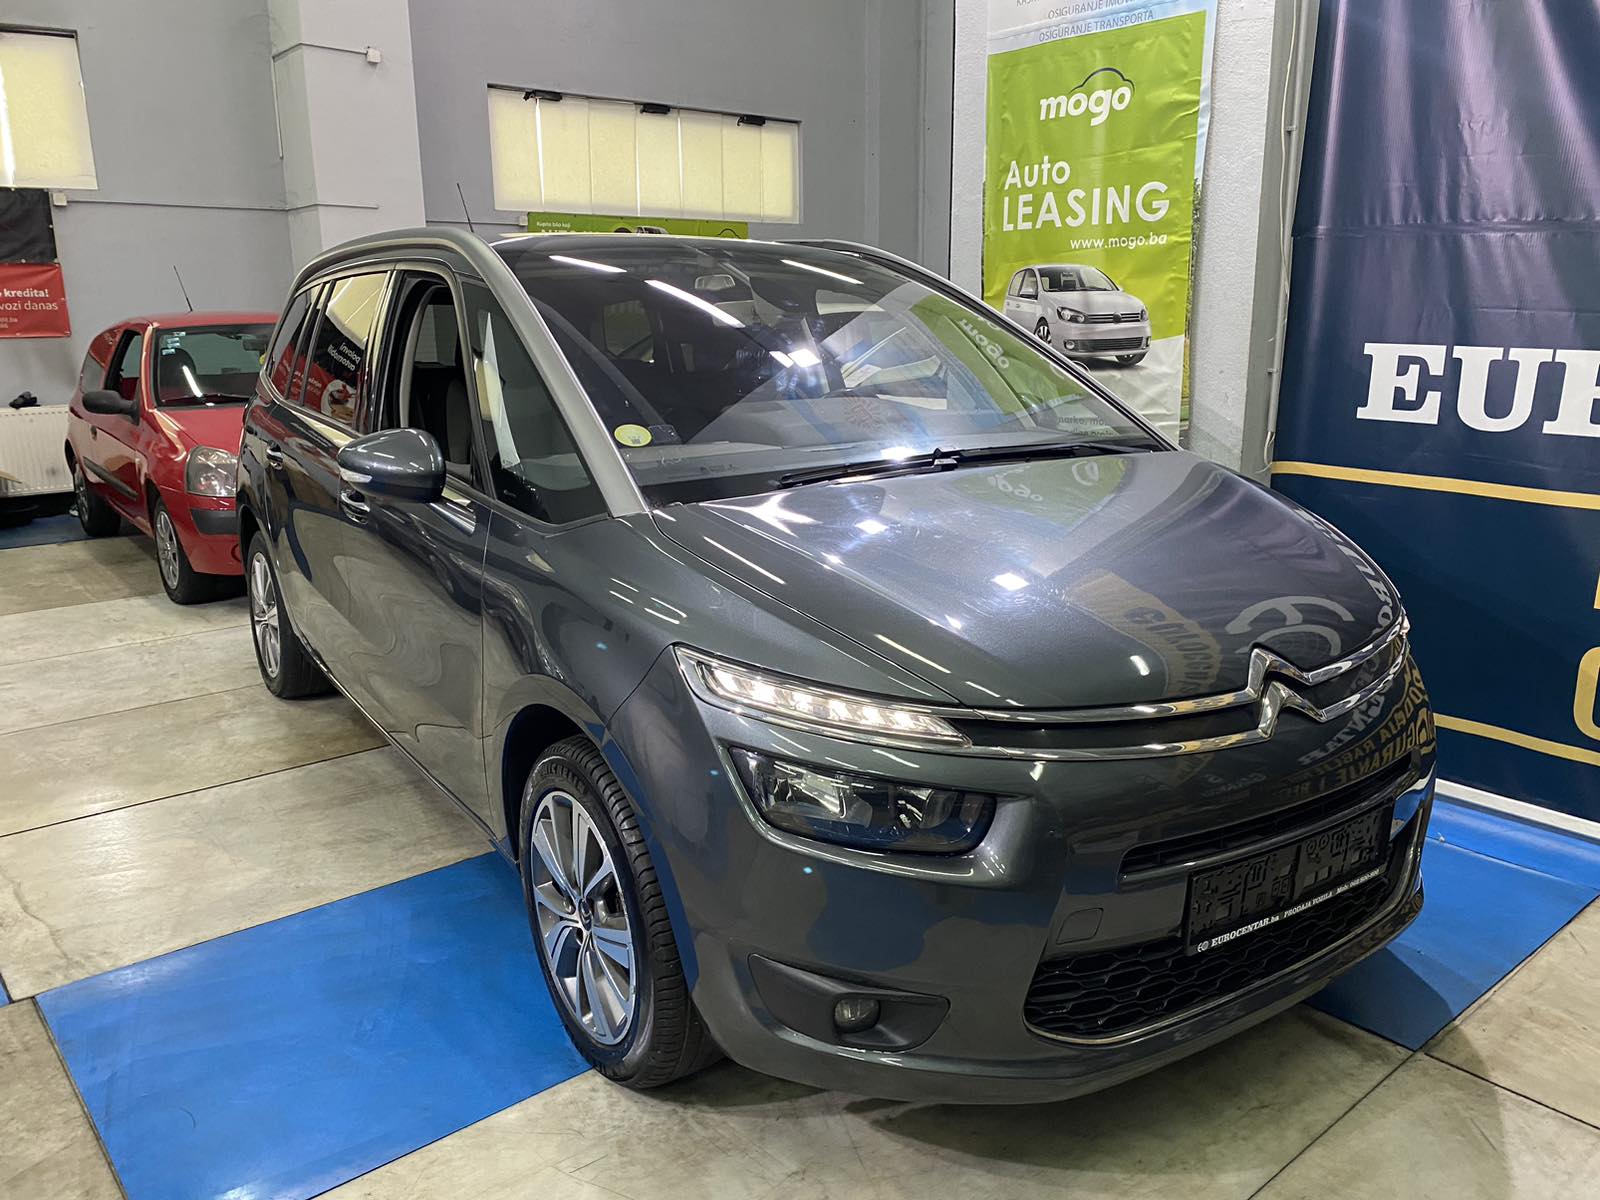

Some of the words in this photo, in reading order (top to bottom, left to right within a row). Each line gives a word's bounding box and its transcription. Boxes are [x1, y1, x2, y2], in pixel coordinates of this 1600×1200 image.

[1048, 1, 1104, 19] OSIGURANJE
[1038, 22, 1092, 42] OSIGURANJE
[1094, 10, 1154, 31] TRANSPORTA
[1039, 86, 1132, 126] mogo
[1004, 156, 1070, 190] Auto
[1002, 181, 1170, 232] LEASING
[1070, 232, 1168, 250] www.mogo.ba
[3, 287, 49, 298] kredita!
[24, 300, 58, 310] danas
